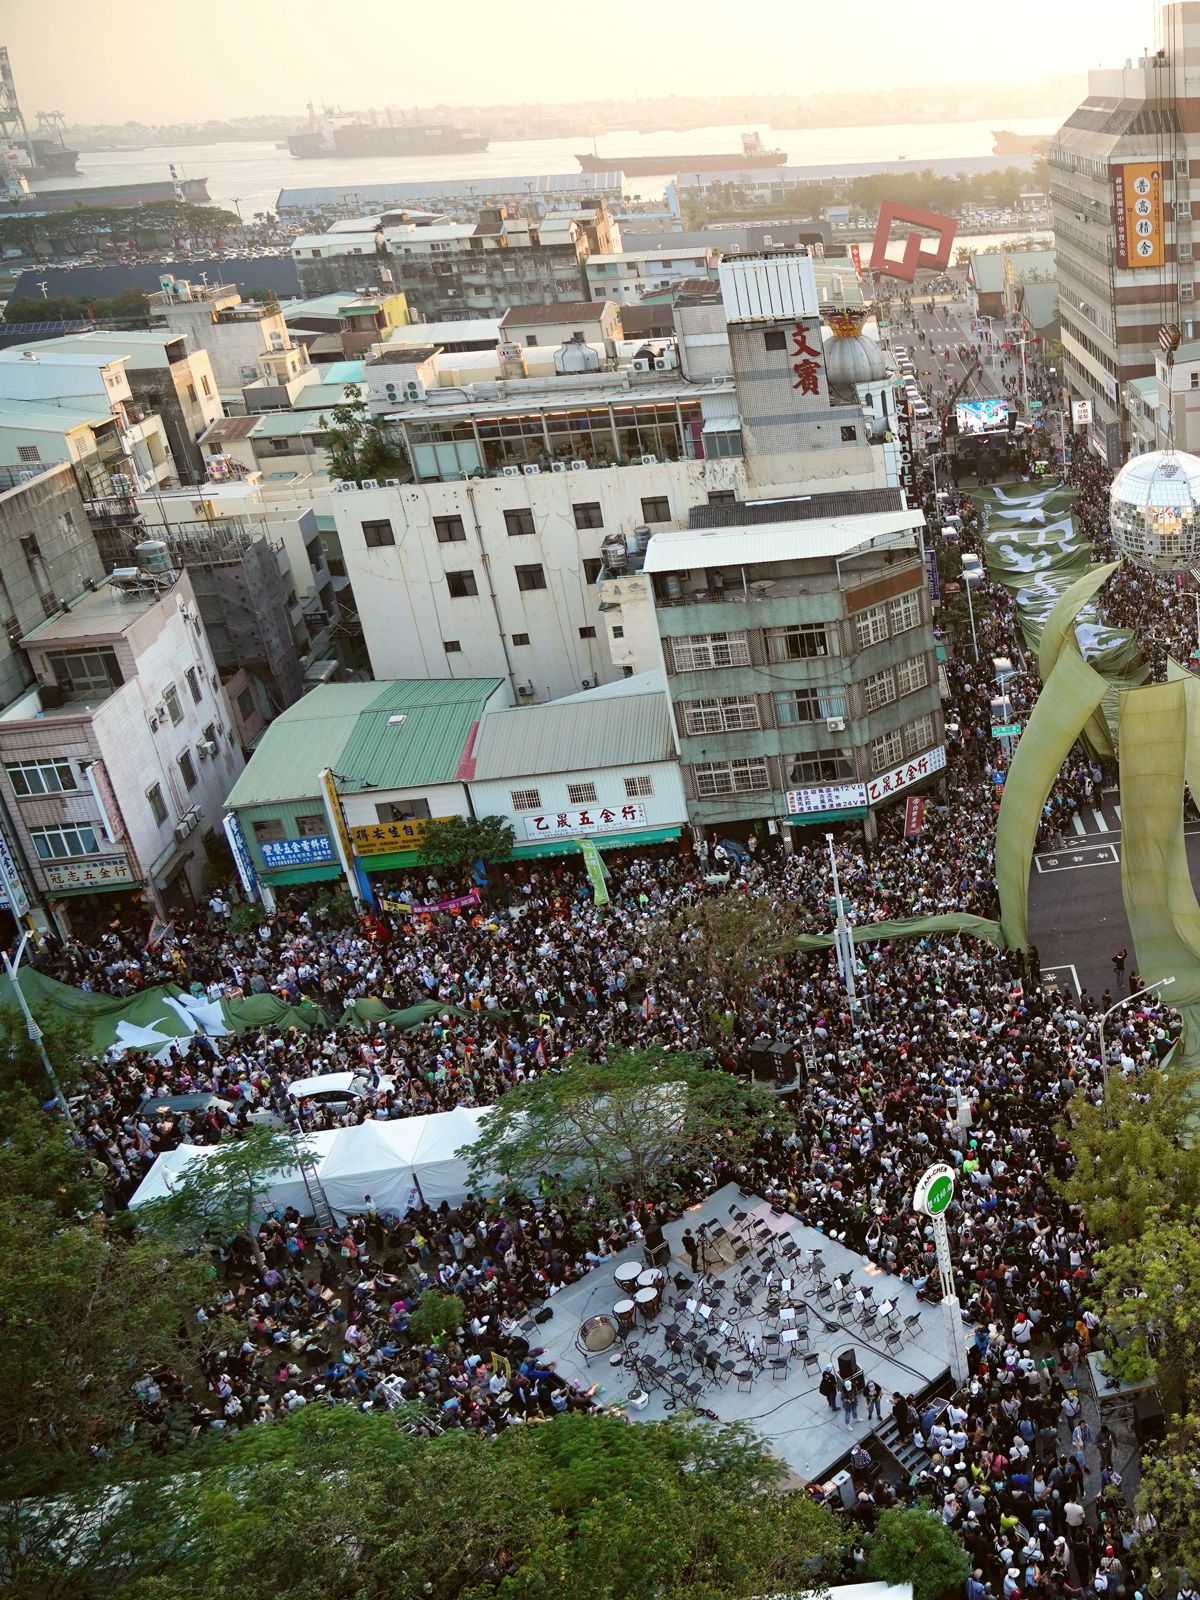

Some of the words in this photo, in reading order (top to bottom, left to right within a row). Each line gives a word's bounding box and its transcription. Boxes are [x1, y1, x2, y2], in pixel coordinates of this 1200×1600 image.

[790, 322, 821, 396] 文賓
[901, 442, 914, 497] HOTEL
[533, 805, 637, 831] 乙晟五金行
[50, 865, 128, 884] 冠志五金行
[920, 1165, 948, 1191] YAN-CHEN
